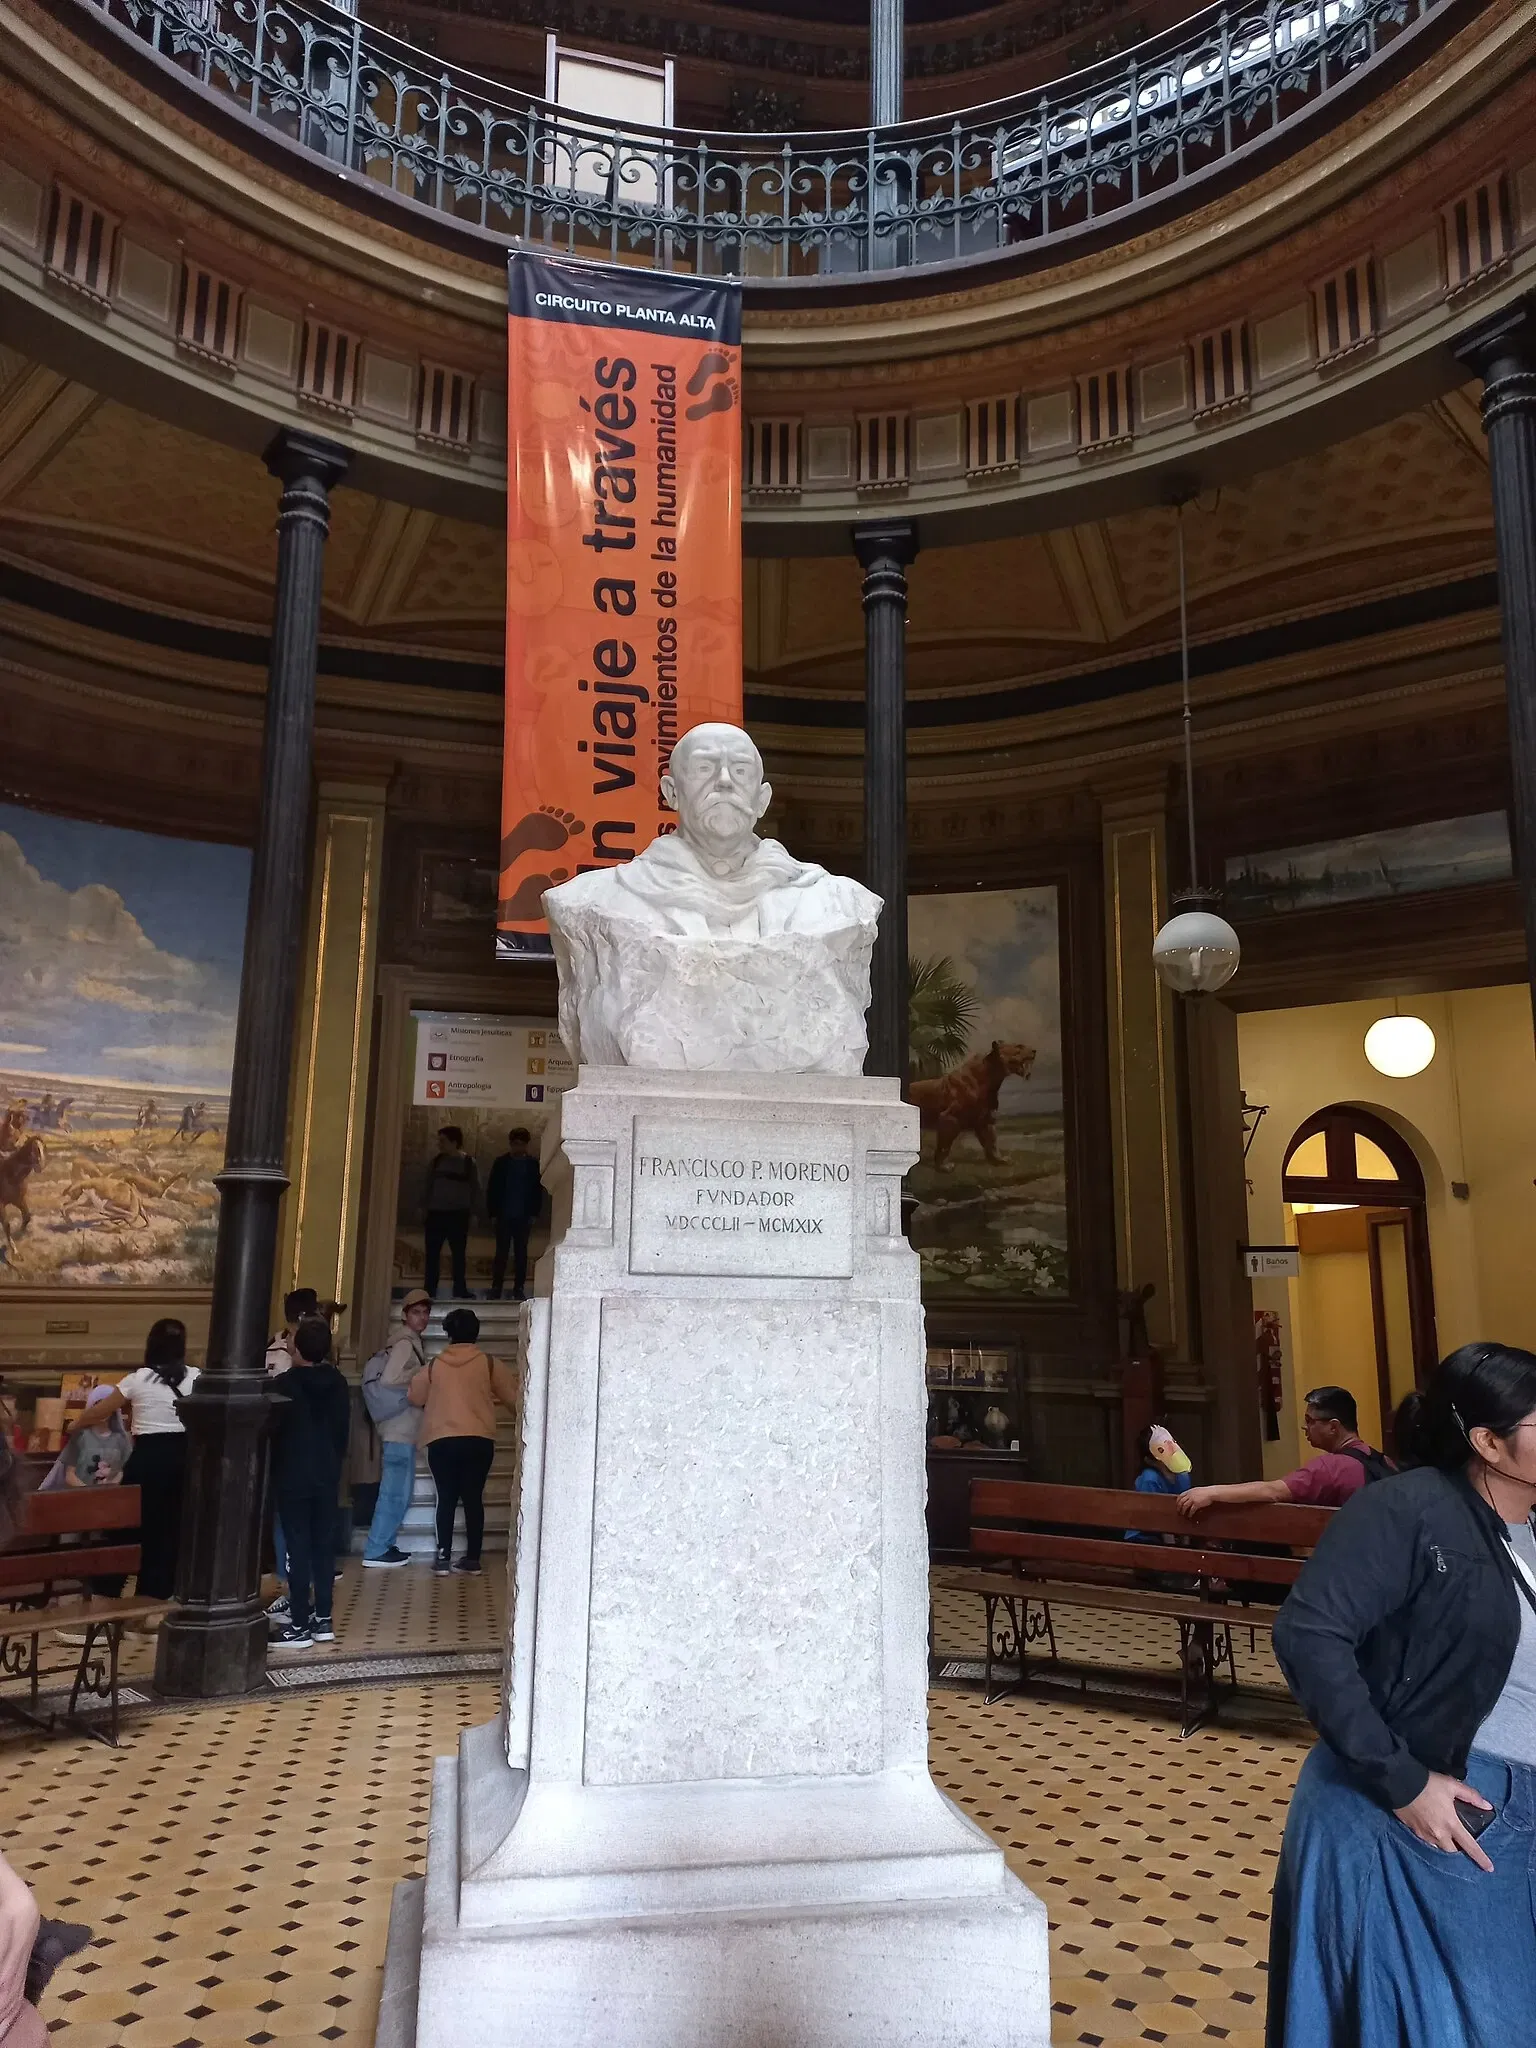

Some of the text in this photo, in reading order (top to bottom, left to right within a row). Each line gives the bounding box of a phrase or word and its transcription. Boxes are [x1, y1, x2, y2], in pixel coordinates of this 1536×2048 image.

[535, 292, 716, 330] CIRCUITO PLANTA ALTA
[580, 356, 637, 553] través
[650, 364, 677, 532] humanidad
[650, 537, 677, 562] la
[593, 576, 637, 617] a
[650, 571, 677, 608] de
[578, 638, 650, 795] viaje
[639, 1156, 850, 1182] FRANCISCO P. MORENO
[696, 1189, 795, 1207] FVNDADOR
[758, 1217, 824, 1234] MCMXIX
